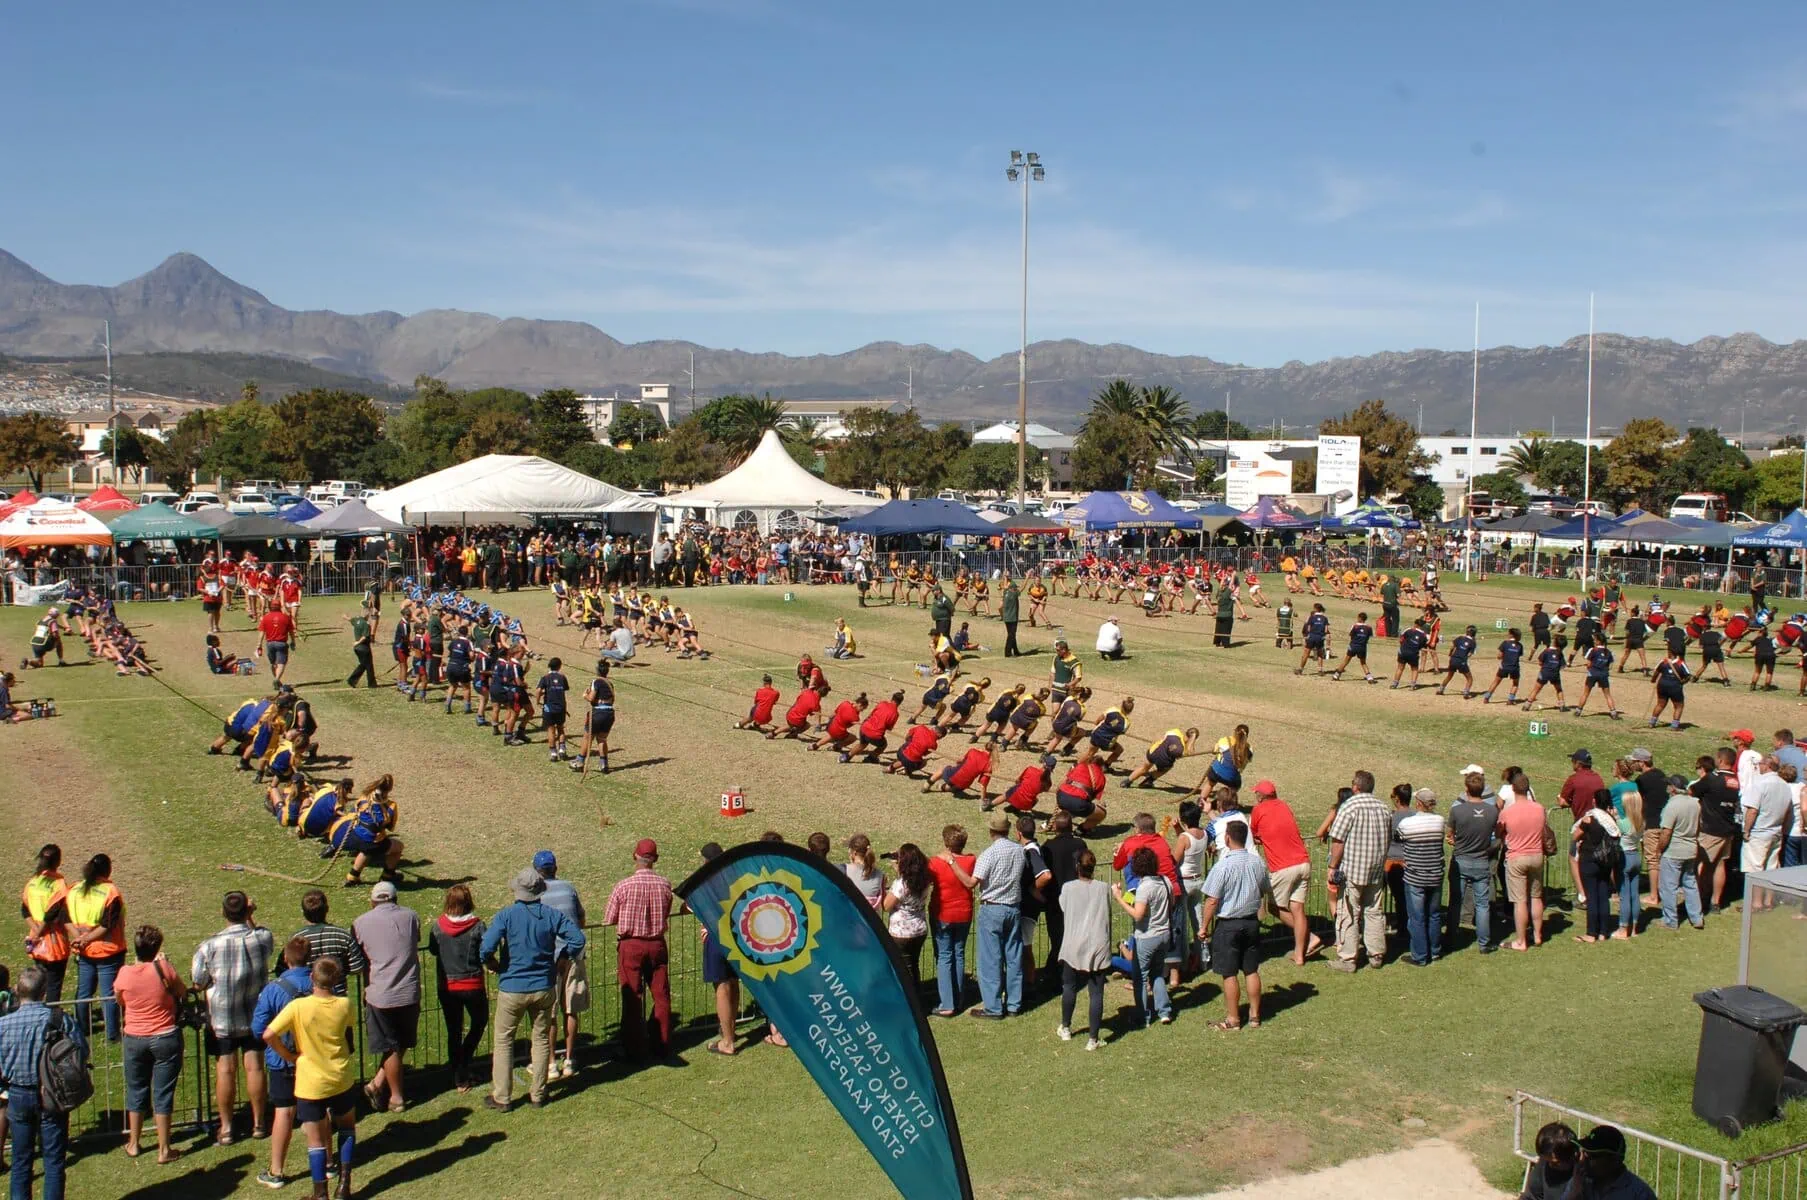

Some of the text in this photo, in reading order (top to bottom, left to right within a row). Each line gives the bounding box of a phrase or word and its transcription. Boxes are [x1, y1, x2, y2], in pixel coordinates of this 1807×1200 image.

[1768, 538, 1803, 548] Swartland
[723, 797, 727, 806] 5
[735, 797, 741, 807] 5
